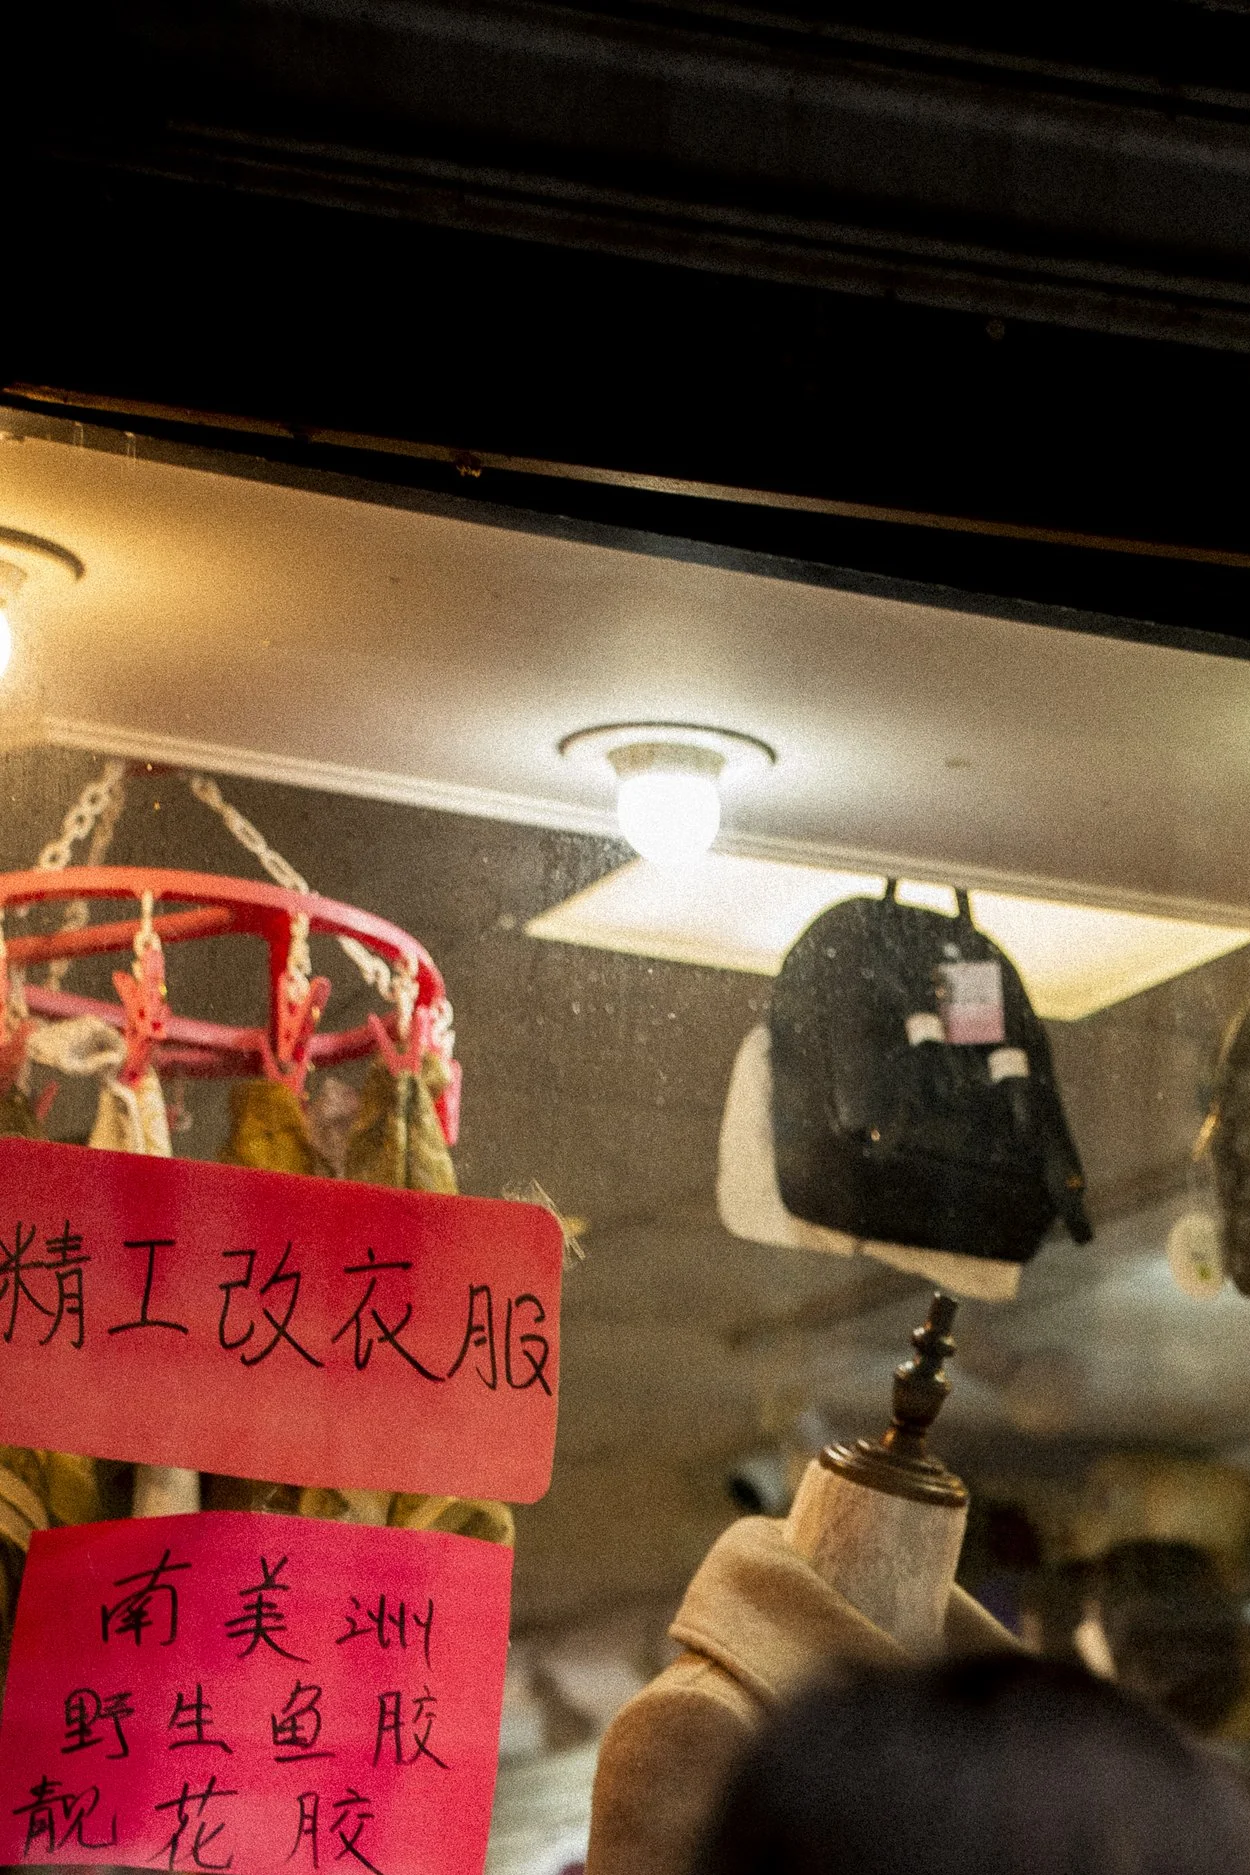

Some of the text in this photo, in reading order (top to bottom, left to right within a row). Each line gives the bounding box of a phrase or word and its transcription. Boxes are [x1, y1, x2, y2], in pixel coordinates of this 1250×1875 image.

[0, 1219, 553, 1396] 精工改衣服
[100, 1549, 437, 1671] 南美洲
[61, 1680, 450, 1769] 野生鱼胶
